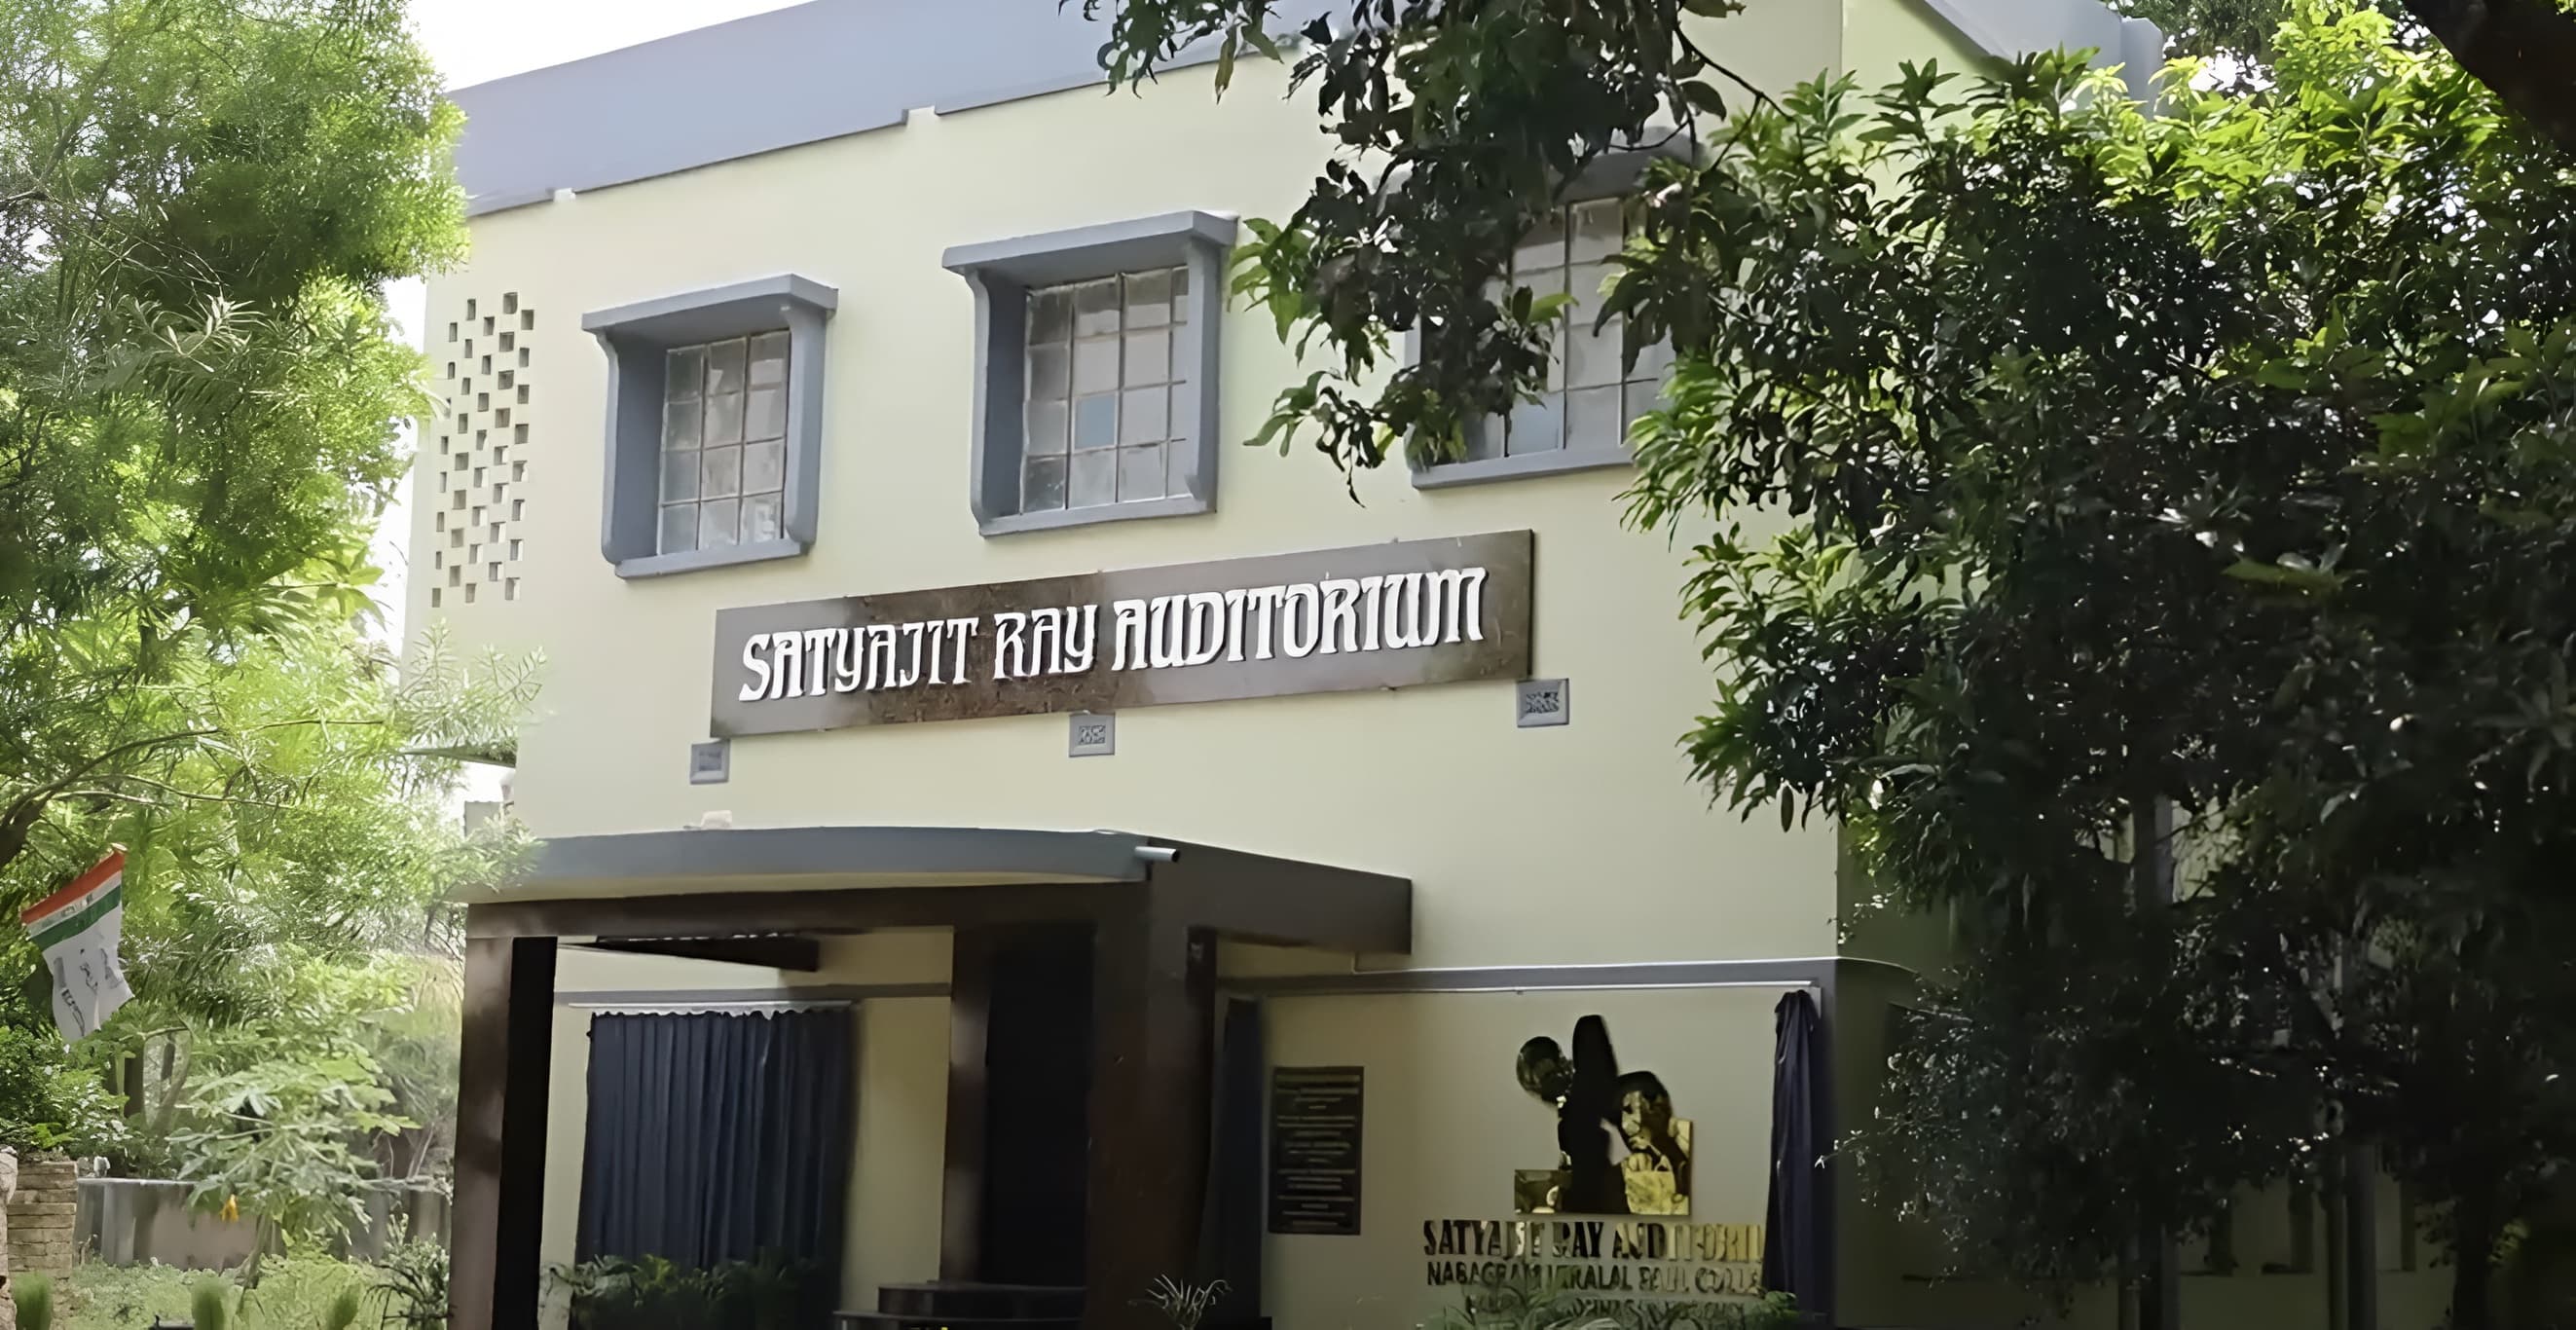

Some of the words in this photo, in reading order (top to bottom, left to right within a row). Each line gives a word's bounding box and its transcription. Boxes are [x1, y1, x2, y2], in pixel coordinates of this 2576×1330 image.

[738, 616, 980, 702] SATYAJIT
[992, 604, 1100, 682] RAY
[1111, 567, 1490, 672] AUDITORIUM
